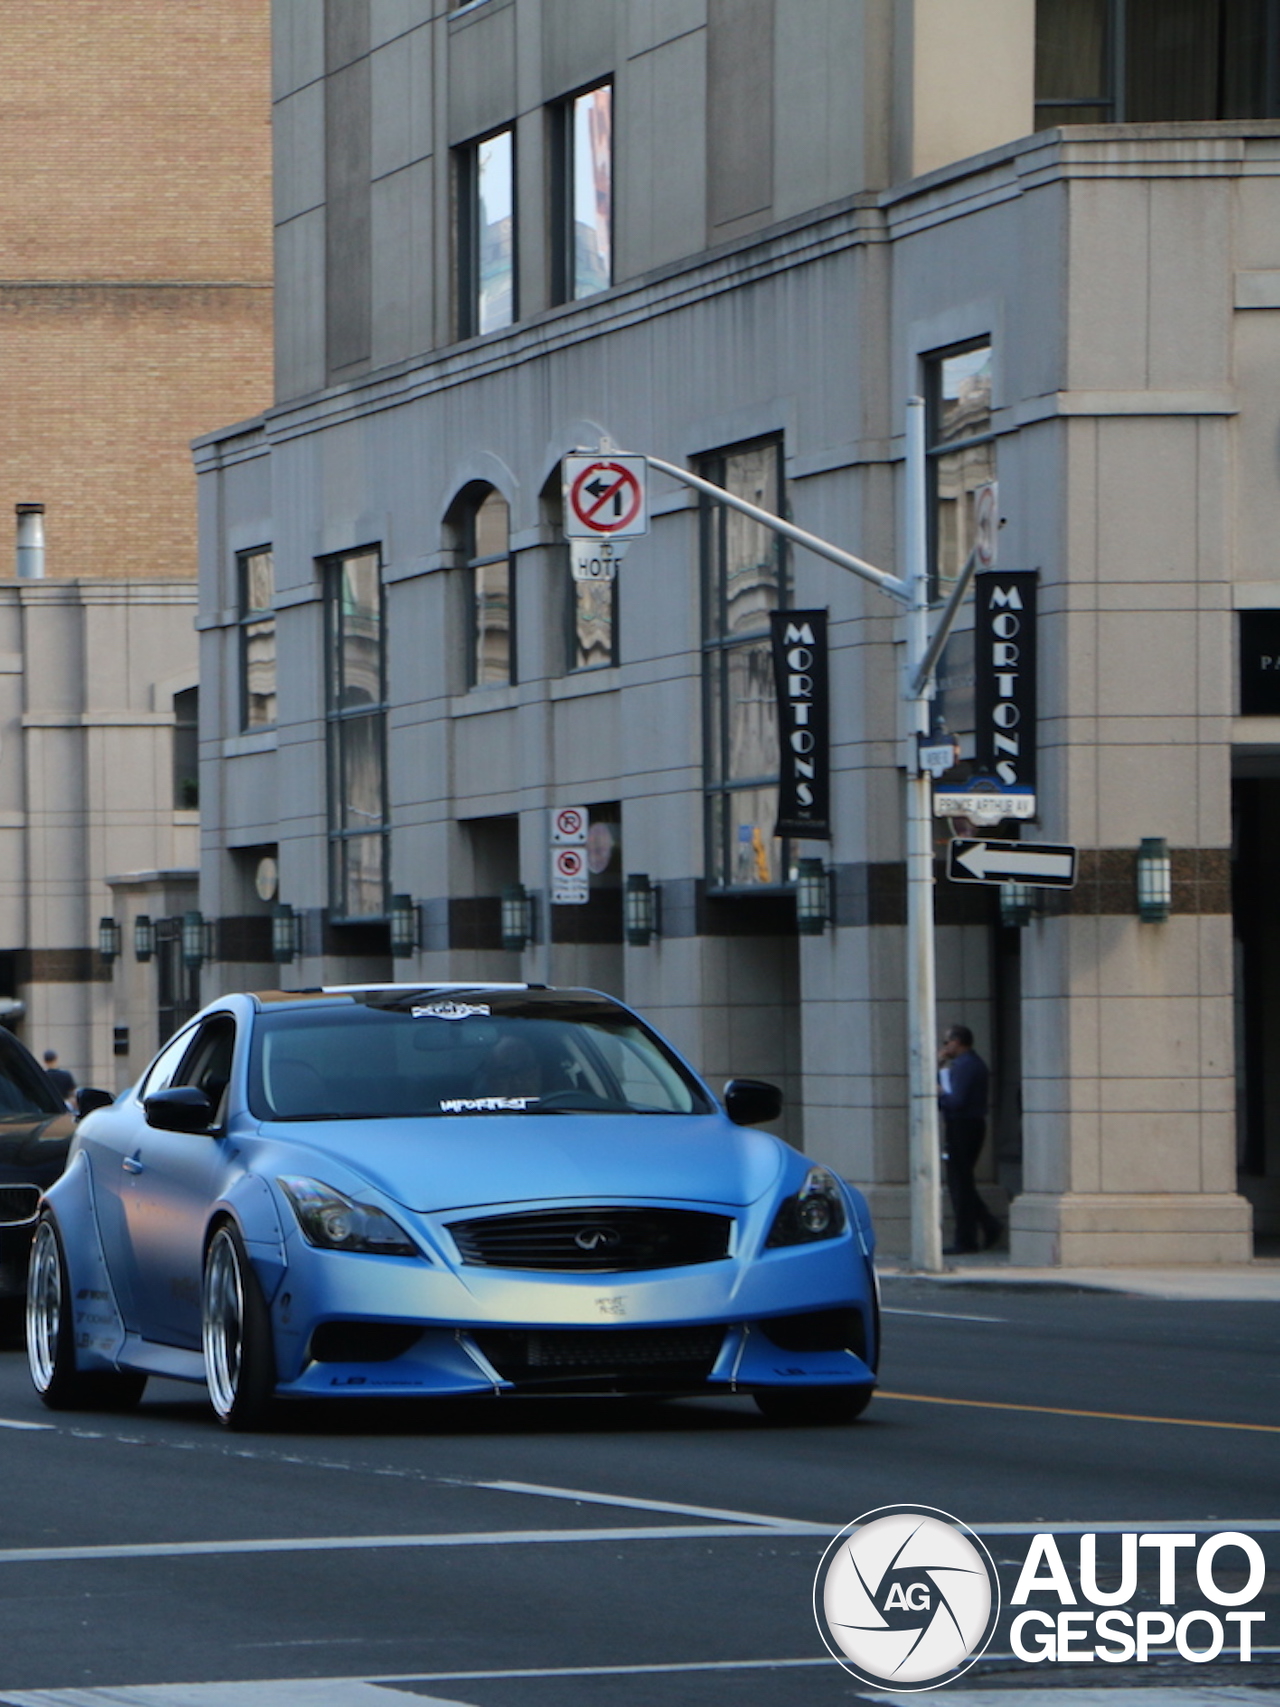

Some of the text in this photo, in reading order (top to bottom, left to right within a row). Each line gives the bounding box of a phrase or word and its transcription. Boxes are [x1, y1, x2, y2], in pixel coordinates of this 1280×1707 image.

[600, 543, 614, 556] TO
[783, 622, 815, 807] MORTONS
[989, 585, 1023, 786] MORTONS
